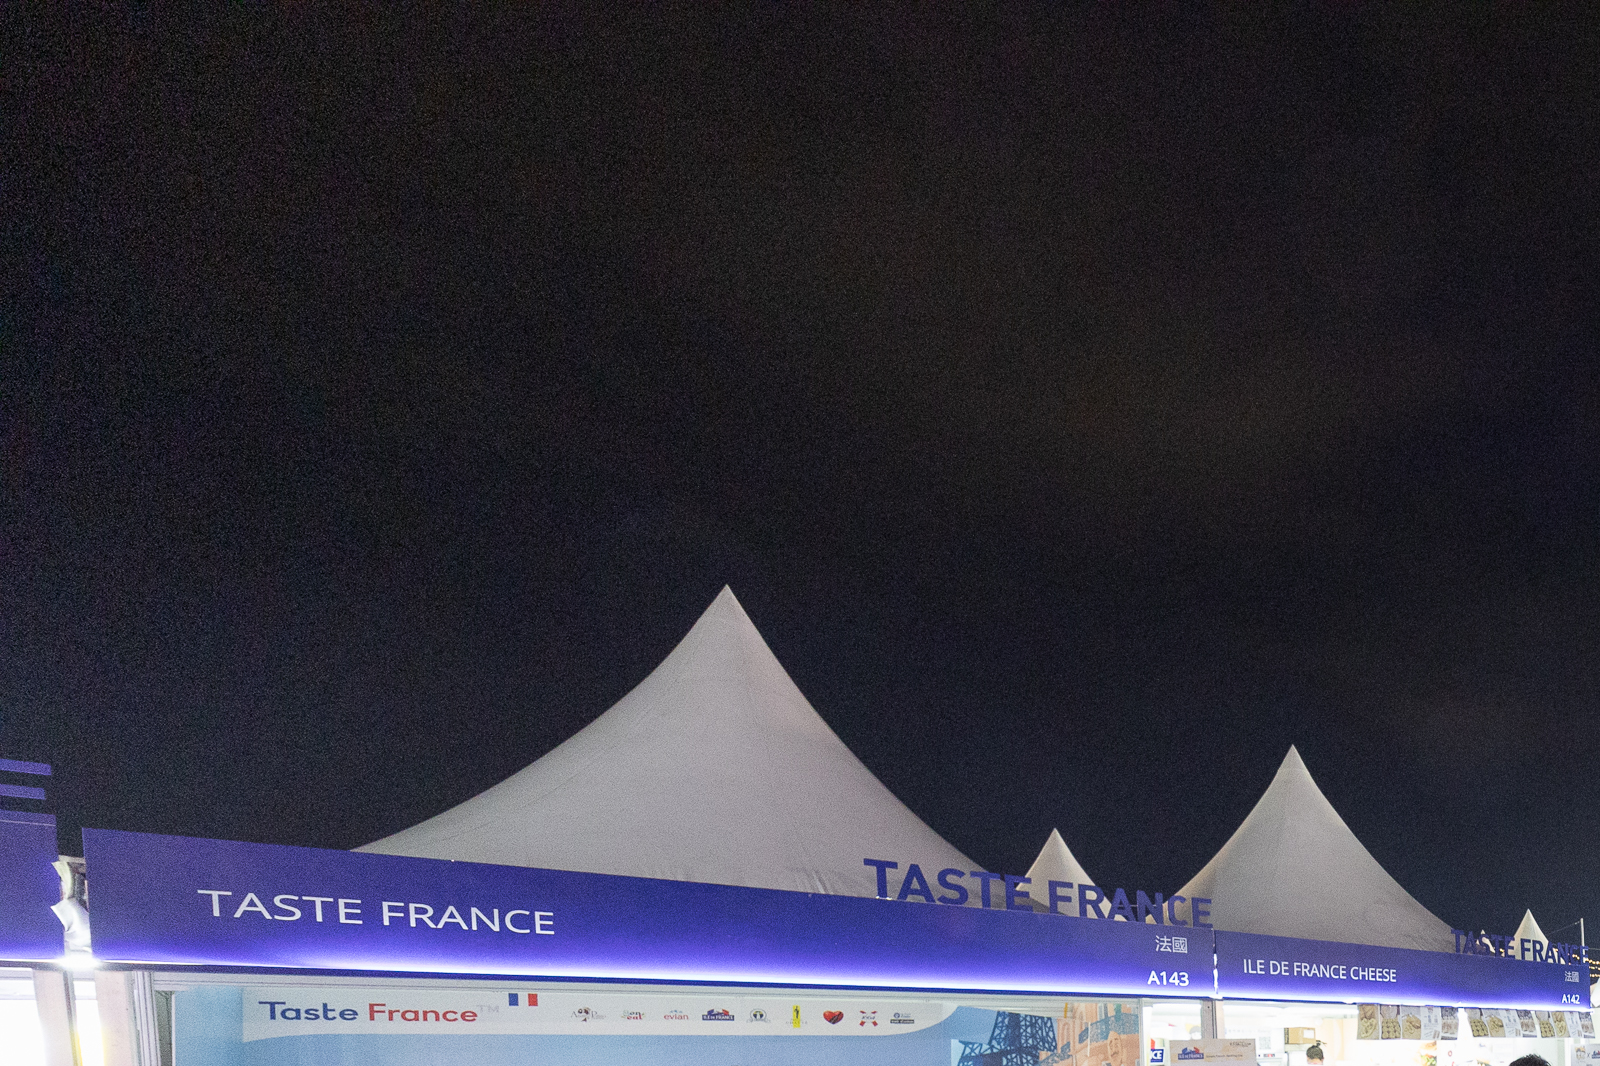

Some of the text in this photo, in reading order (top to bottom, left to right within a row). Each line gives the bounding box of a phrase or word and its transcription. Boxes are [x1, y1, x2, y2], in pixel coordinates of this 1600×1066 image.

[863, 858, 1213, 929] TASTE FRANCE
[197, 889, 555, 935] TASTE FRANCE
[1155, 935, 1188, 953] 法國
[1451, 928, 1589, 966] TASTE FRANCE
[1147, 970, 1190, 987] A143
[1243, 959, 1397, 983] ILE DE FRANCE CHEESE
[1564, 970, 1580, 983] 法國
[1561, 993, 1581, 1004] A142
[258, 1000, 359, 1021] Taste
[368, 1003, 478, 1022] France
